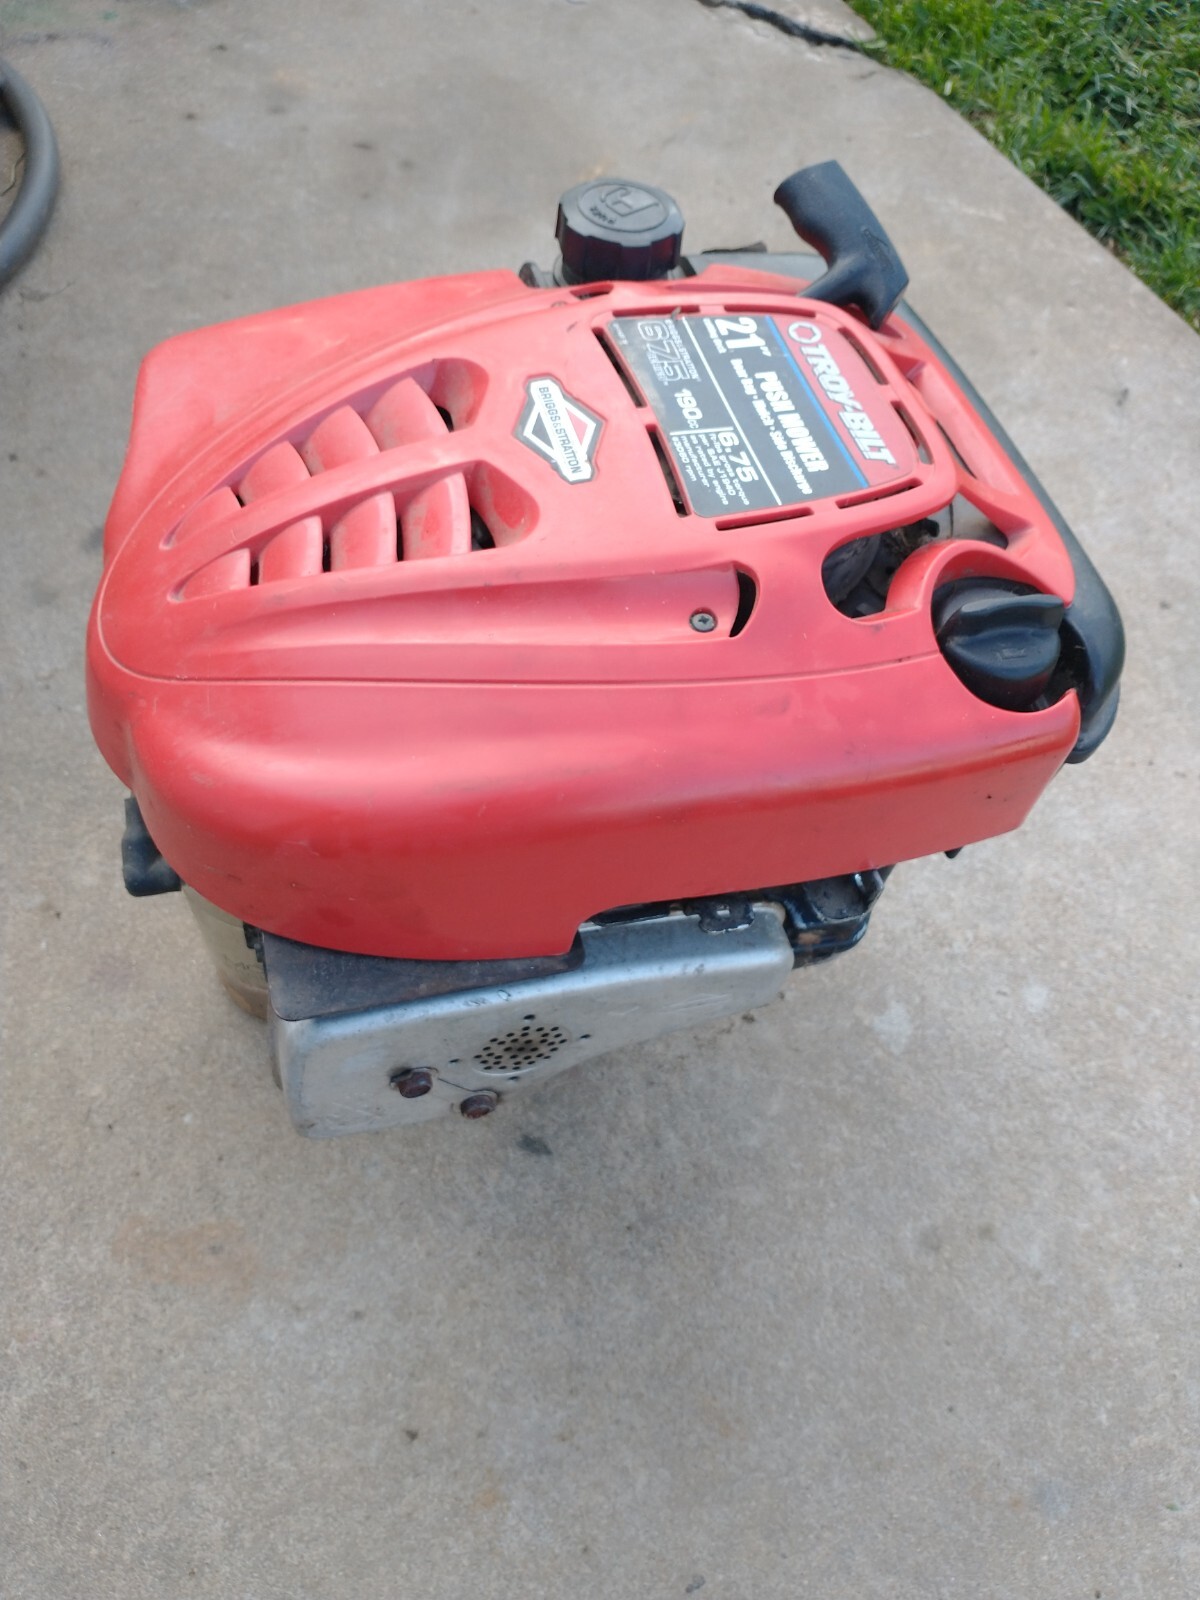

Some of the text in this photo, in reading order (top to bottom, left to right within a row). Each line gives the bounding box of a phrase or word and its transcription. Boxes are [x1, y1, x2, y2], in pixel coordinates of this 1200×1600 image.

[636, 320, 691, 382] 675
[754, 371, 829, 473] PUSH MOWER
[800, 343, 897, 464] TROY-BILT
[680, 435, 710, 488] manufacturer
[685, 464, 697, 482] rpm
[695, 445, 712, 467] rated
[706, 468, 716, 479] by
[712, 479, 729, 505] engine
[697, 433, 737, 496] per SAE J1940
[717, 431, 759, 483] 6.75
[718, 454, 736, 478] gross
[732, 478, 750, 506] torque
[769, 430, 788, 451] Side
[779, 450, 813, 495] Discharge
